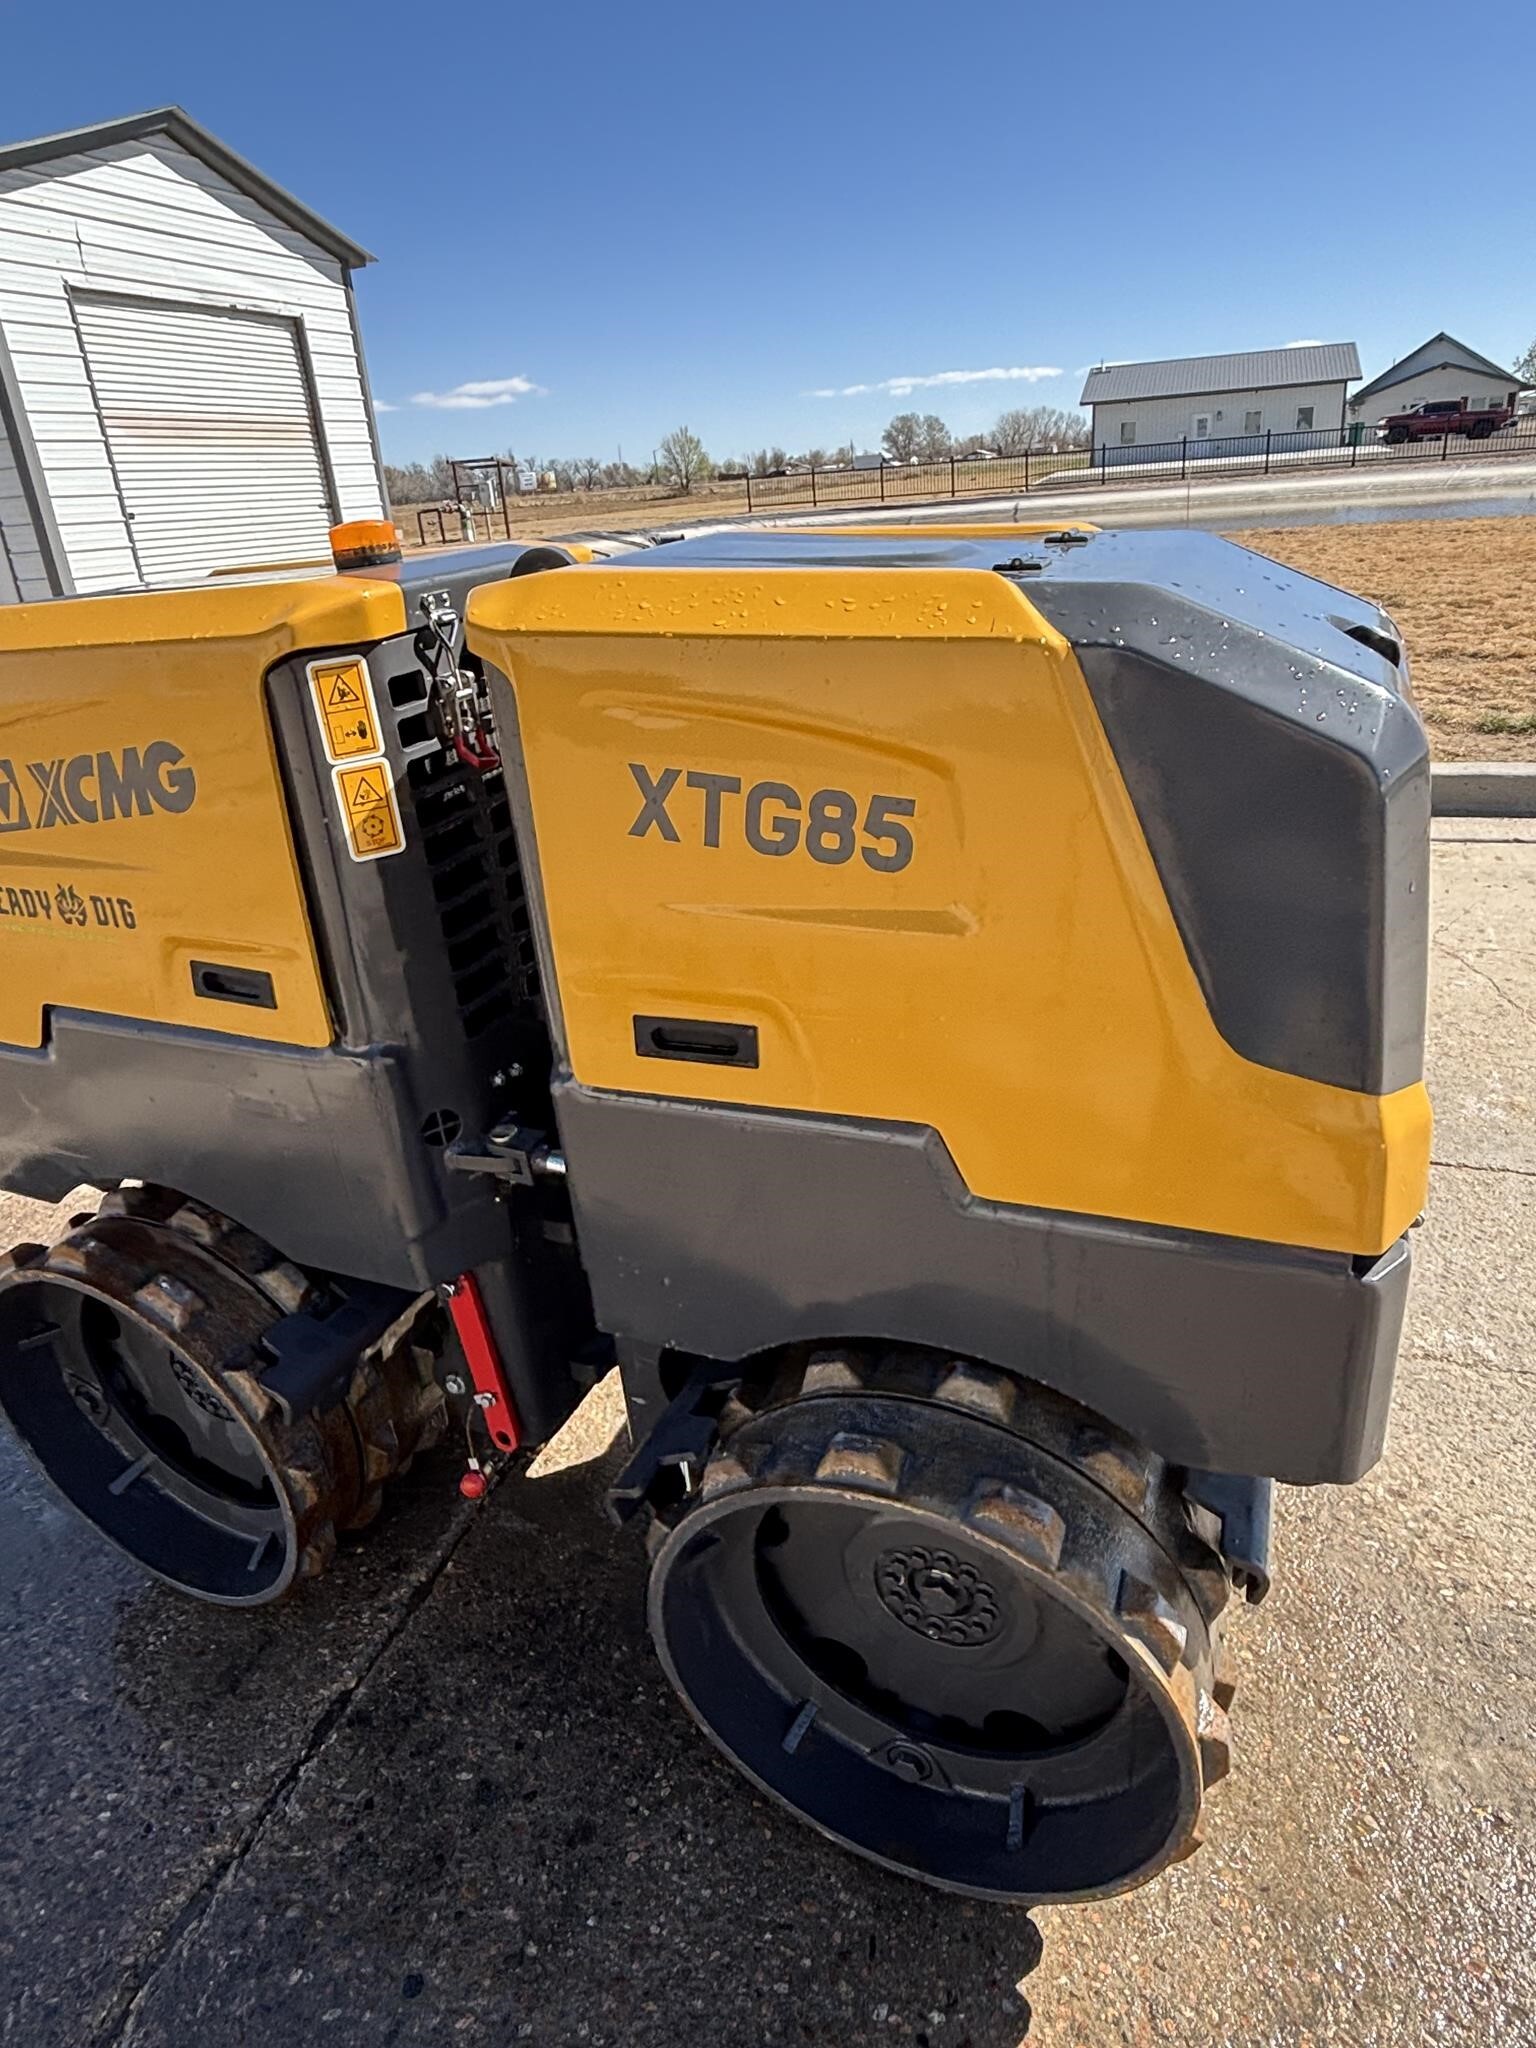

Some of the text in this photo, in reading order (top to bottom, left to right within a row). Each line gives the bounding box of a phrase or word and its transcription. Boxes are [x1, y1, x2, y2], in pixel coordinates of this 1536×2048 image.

[26, 740, 197, 829] XCMG
[627, 763, 916, 873] XTG85
[89, 895, 137, 929] DIG
